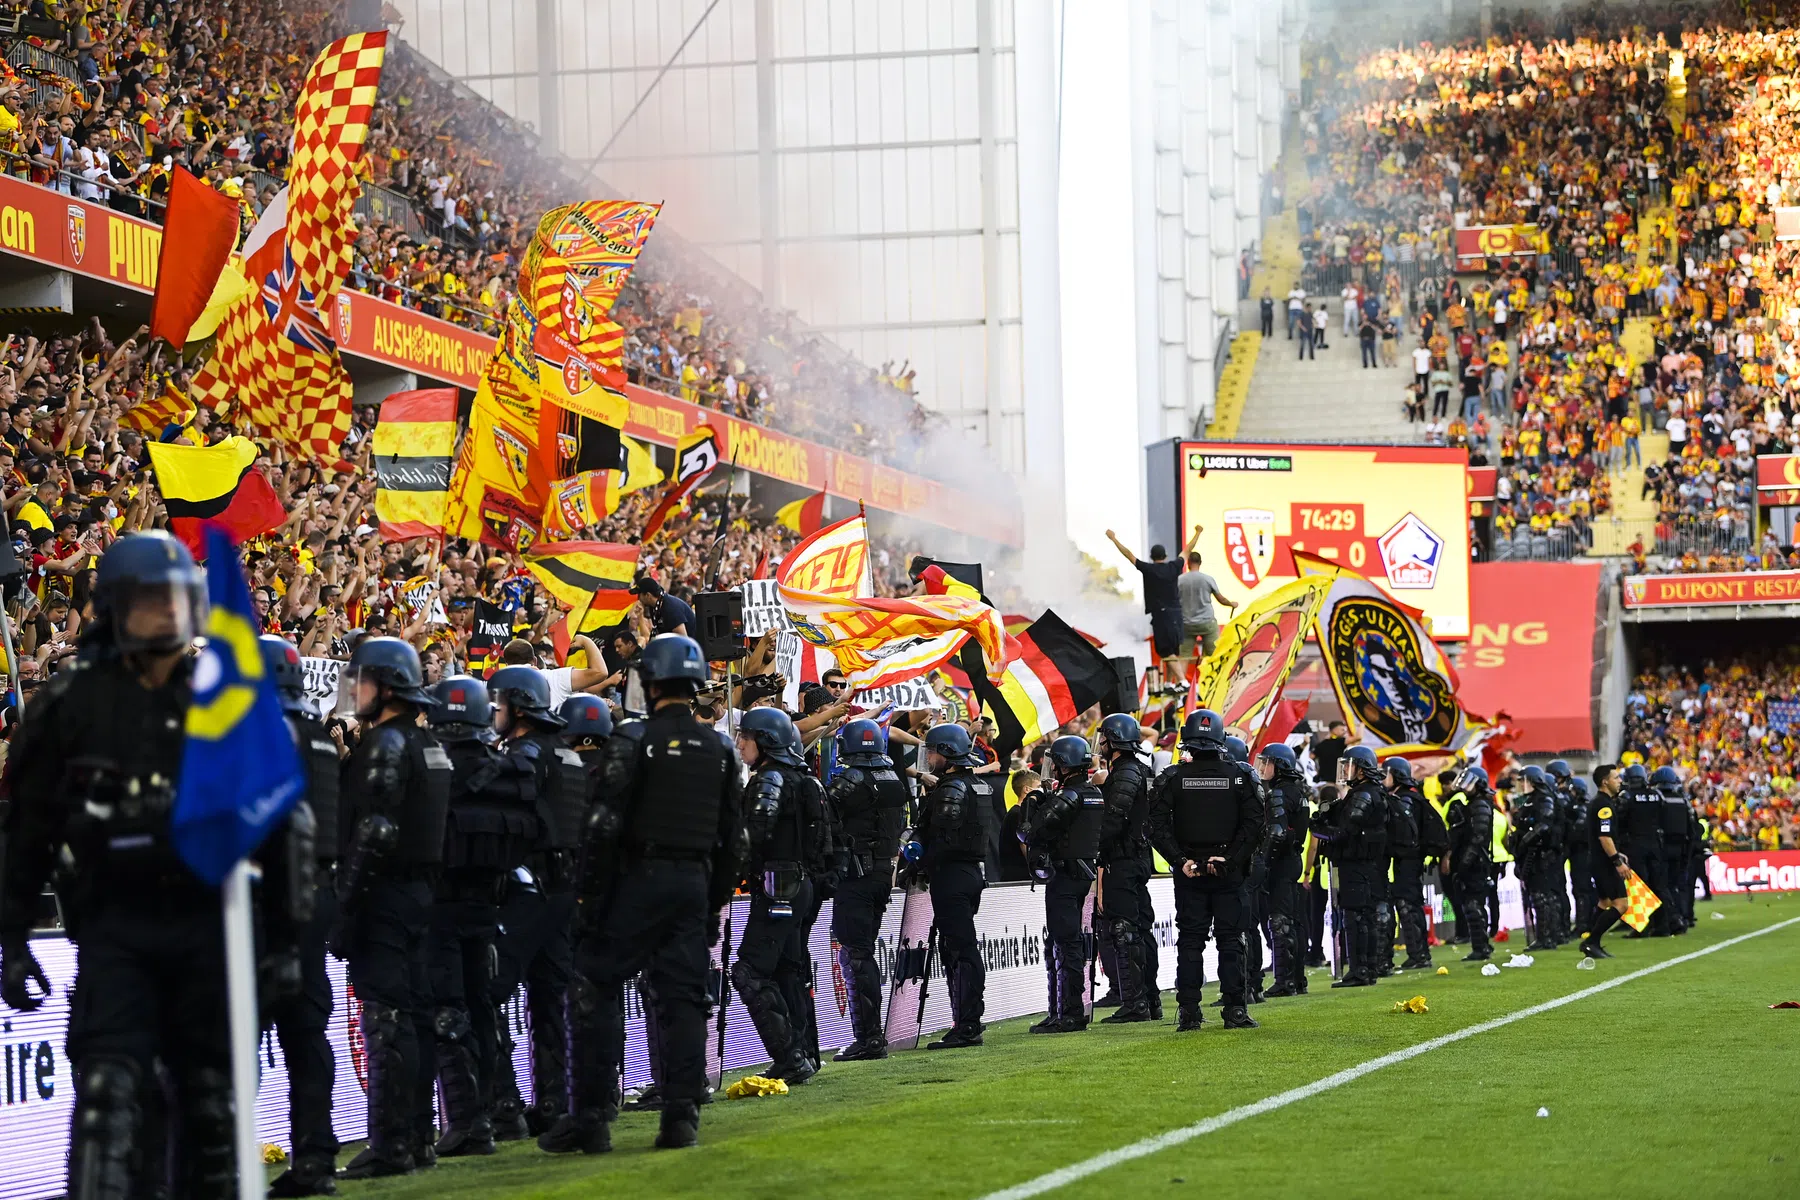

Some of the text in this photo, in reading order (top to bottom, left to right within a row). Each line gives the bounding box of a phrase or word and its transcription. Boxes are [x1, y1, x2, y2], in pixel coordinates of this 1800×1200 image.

[108, 215, 163, 289] PUM
[562, 286, 580, 338] RCL
[491, 365, 509, 381] 12
[566, 401, 609, 421] TOUJOURS
[728, 420, 809, 483] McDonald's
[1204, 457, 1237, 468] LIGUE
[562, 502, 583, 528] RCL
[1300, 508, 1356, 531] 74:29
[1227, 526, 1256, 582] RCL
[1660, 581, 1748, 600] DUPONT
[1365, 609, 1415, 664] ULTRAS
[1022, 924, 1040, 966] des
